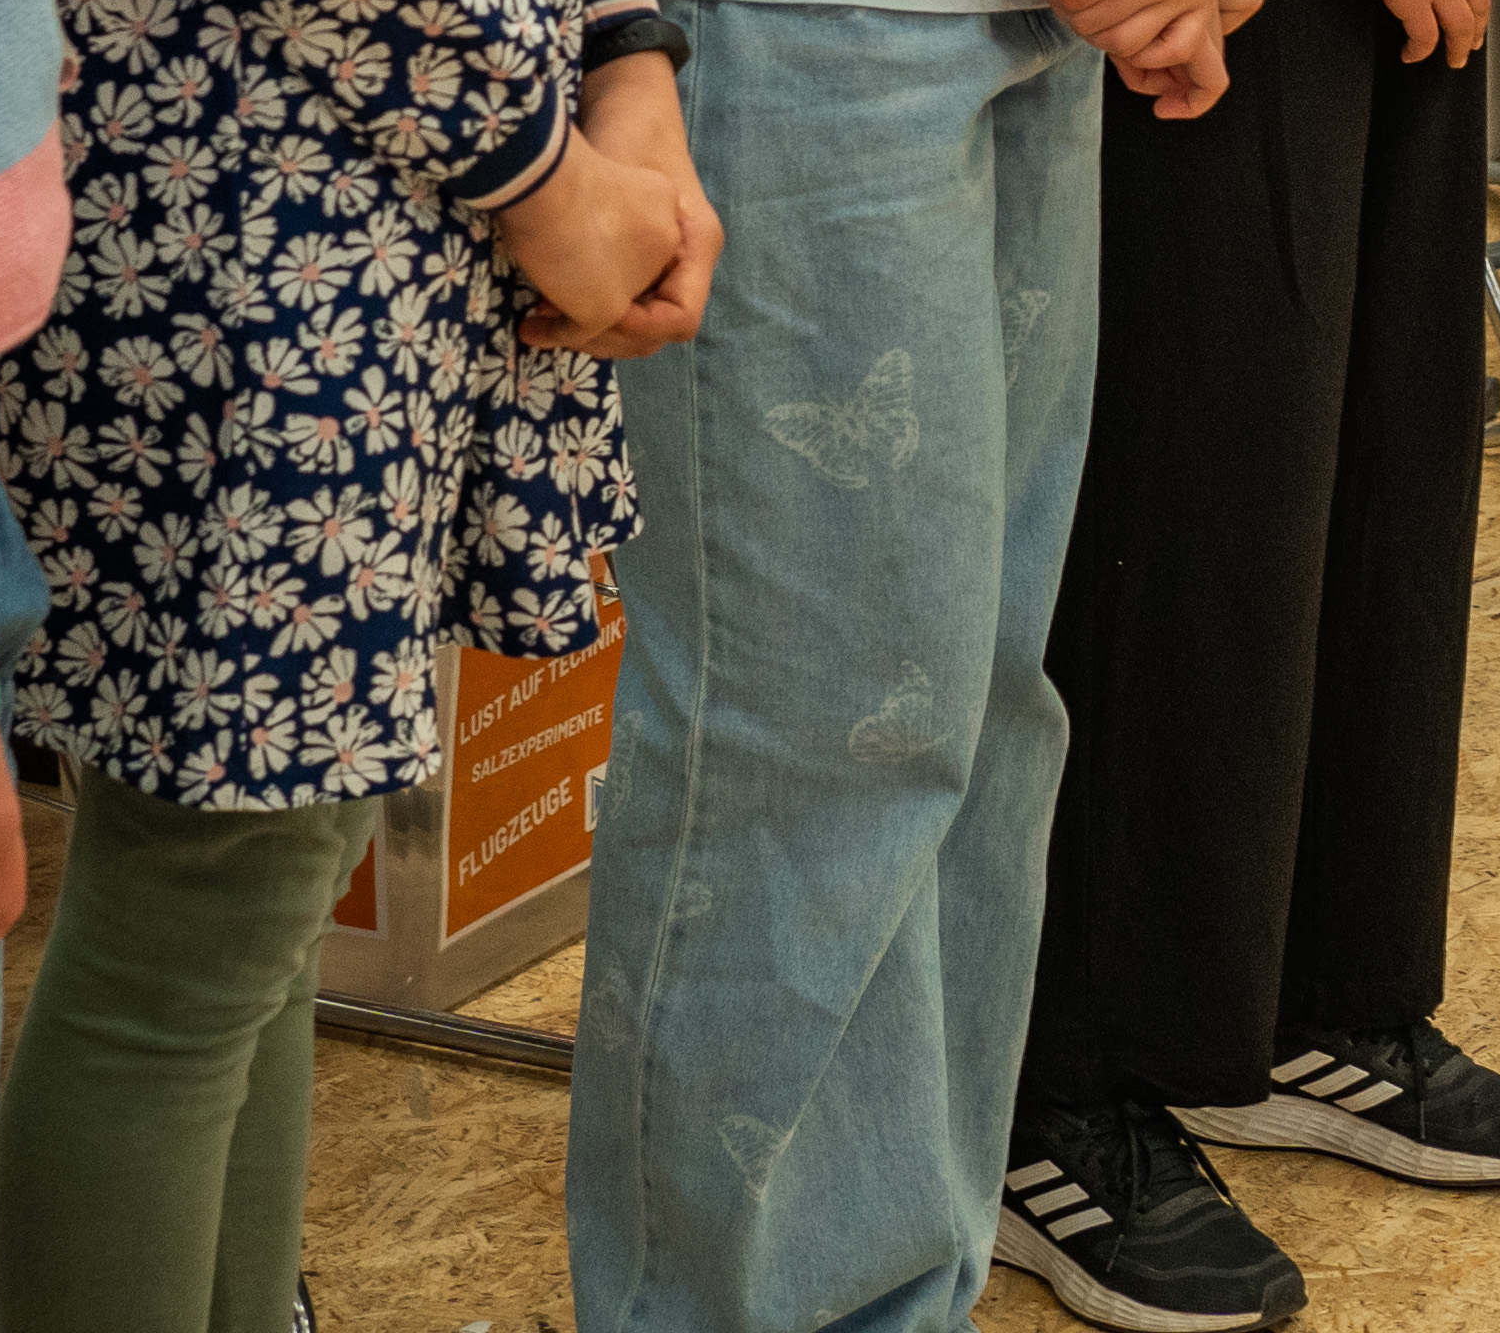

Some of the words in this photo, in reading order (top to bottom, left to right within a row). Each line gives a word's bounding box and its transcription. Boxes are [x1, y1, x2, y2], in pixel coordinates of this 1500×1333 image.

[459, 693, 506, 746] LUST
[508, 667, 545, 712] AUF
[470, 703, 605, 784] SALZEXPERIMENTE
[458, 776, 573, 886] FLUGZEUGE
